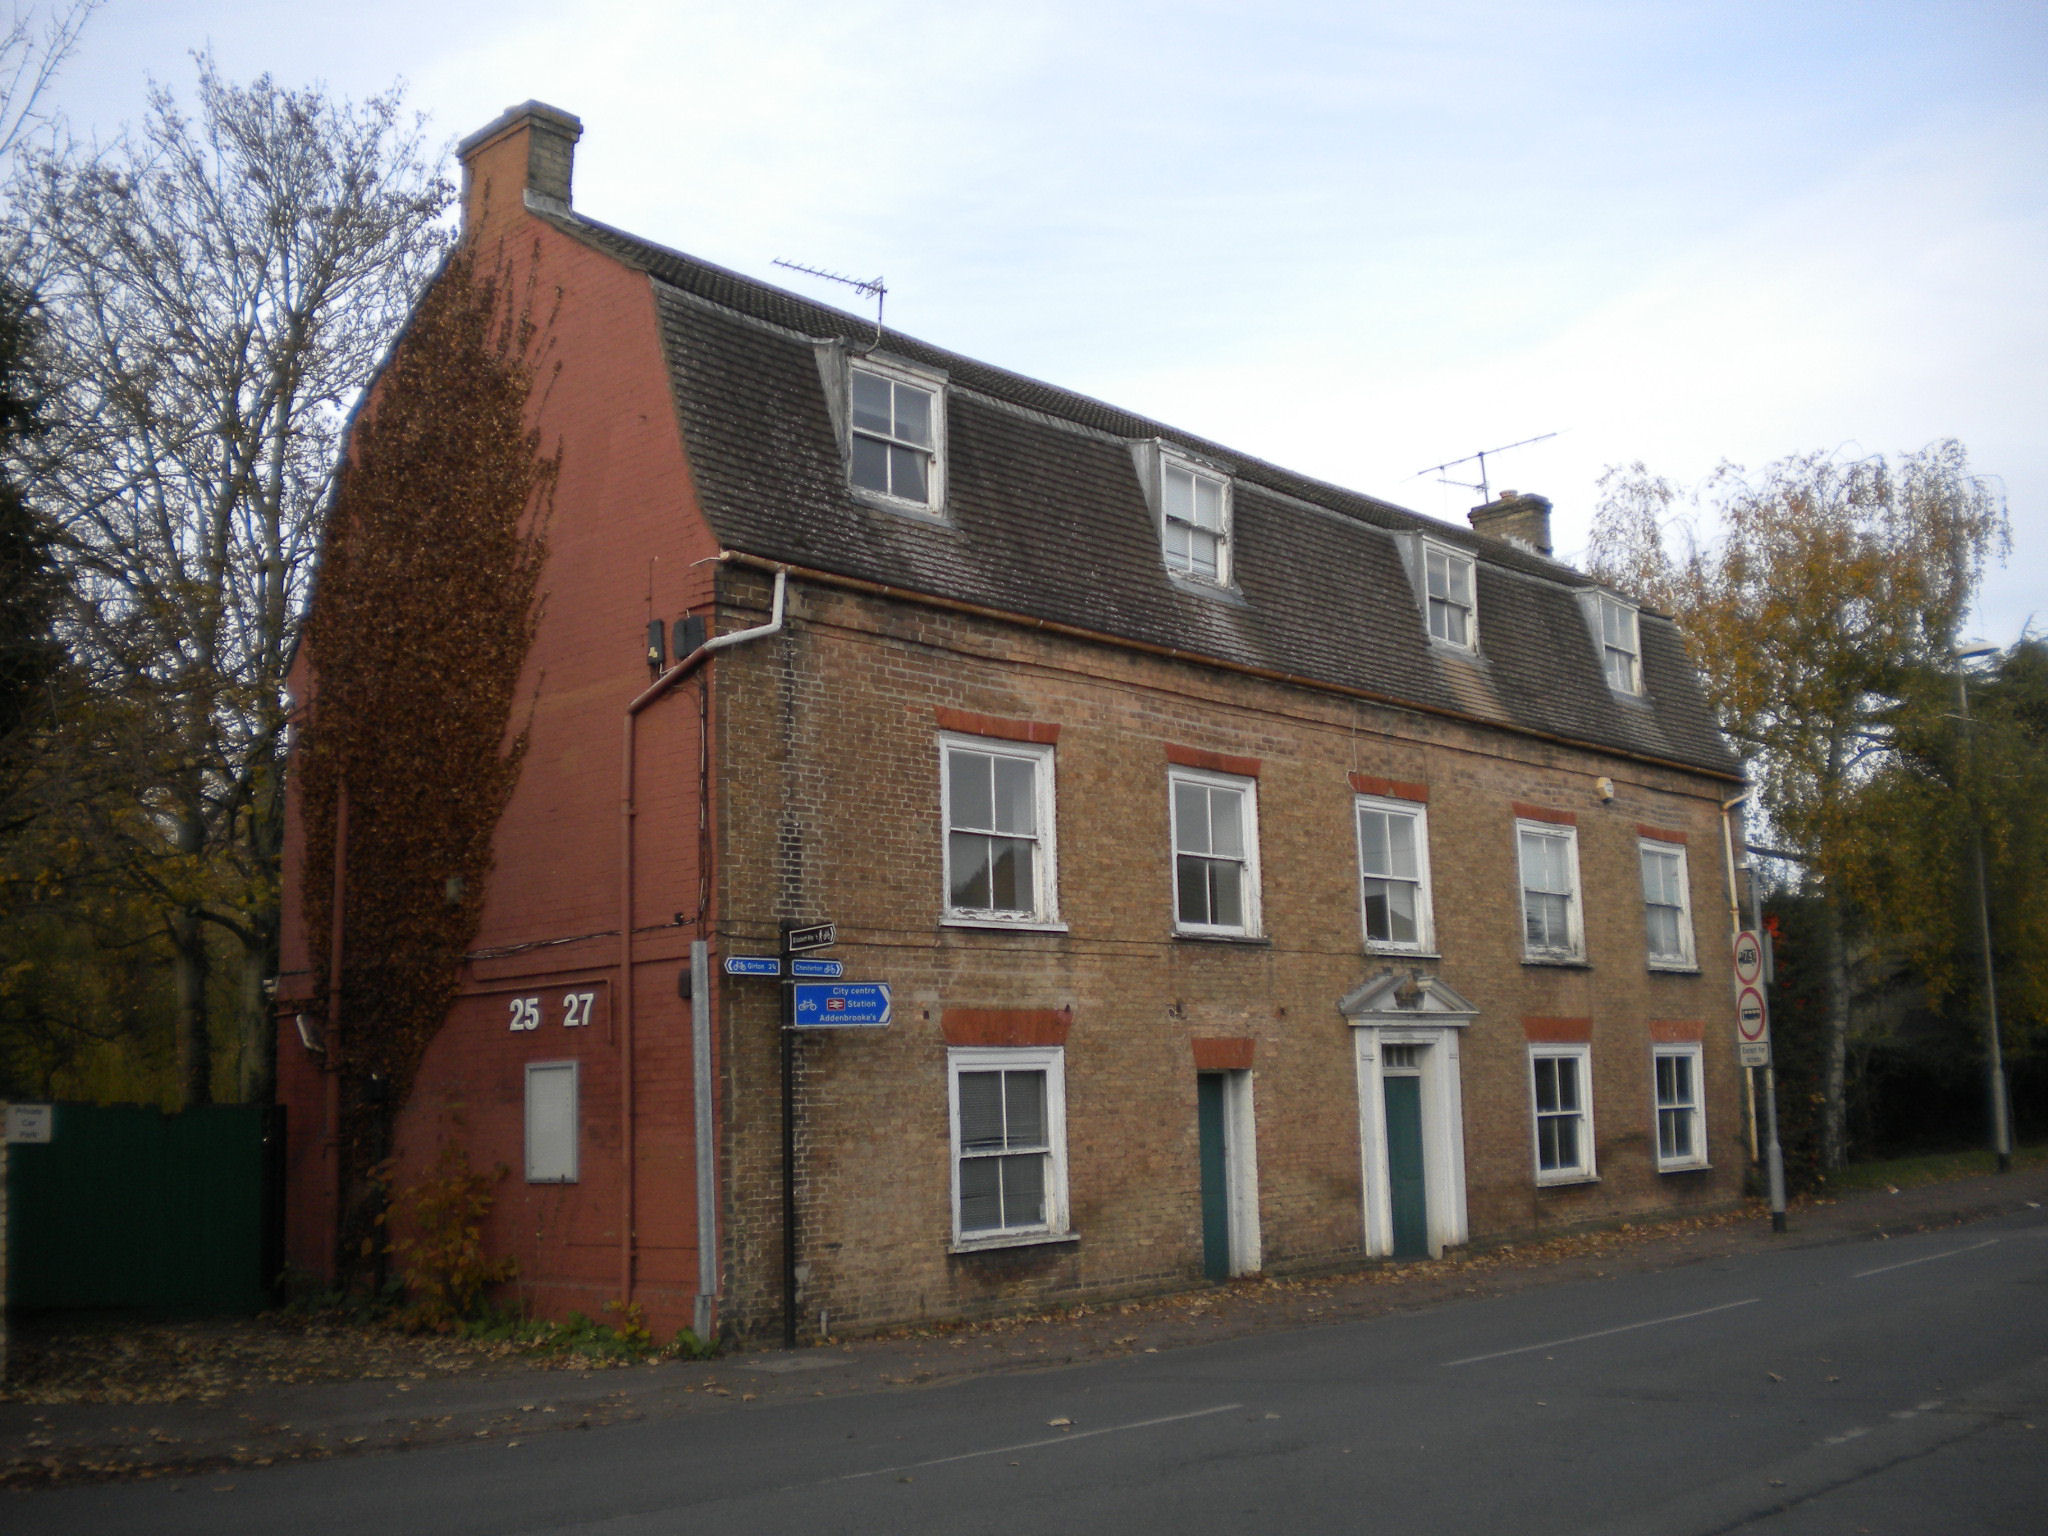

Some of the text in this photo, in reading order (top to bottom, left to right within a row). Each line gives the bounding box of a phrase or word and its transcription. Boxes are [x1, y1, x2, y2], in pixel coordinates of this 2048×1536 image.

[832, 986, 876, 996] City centre
[847, 1000, 876, 1008] Station
[509, 993, 594, 1031] 25 27
[820, 1014, 876, 1022] Addenbrooke's
